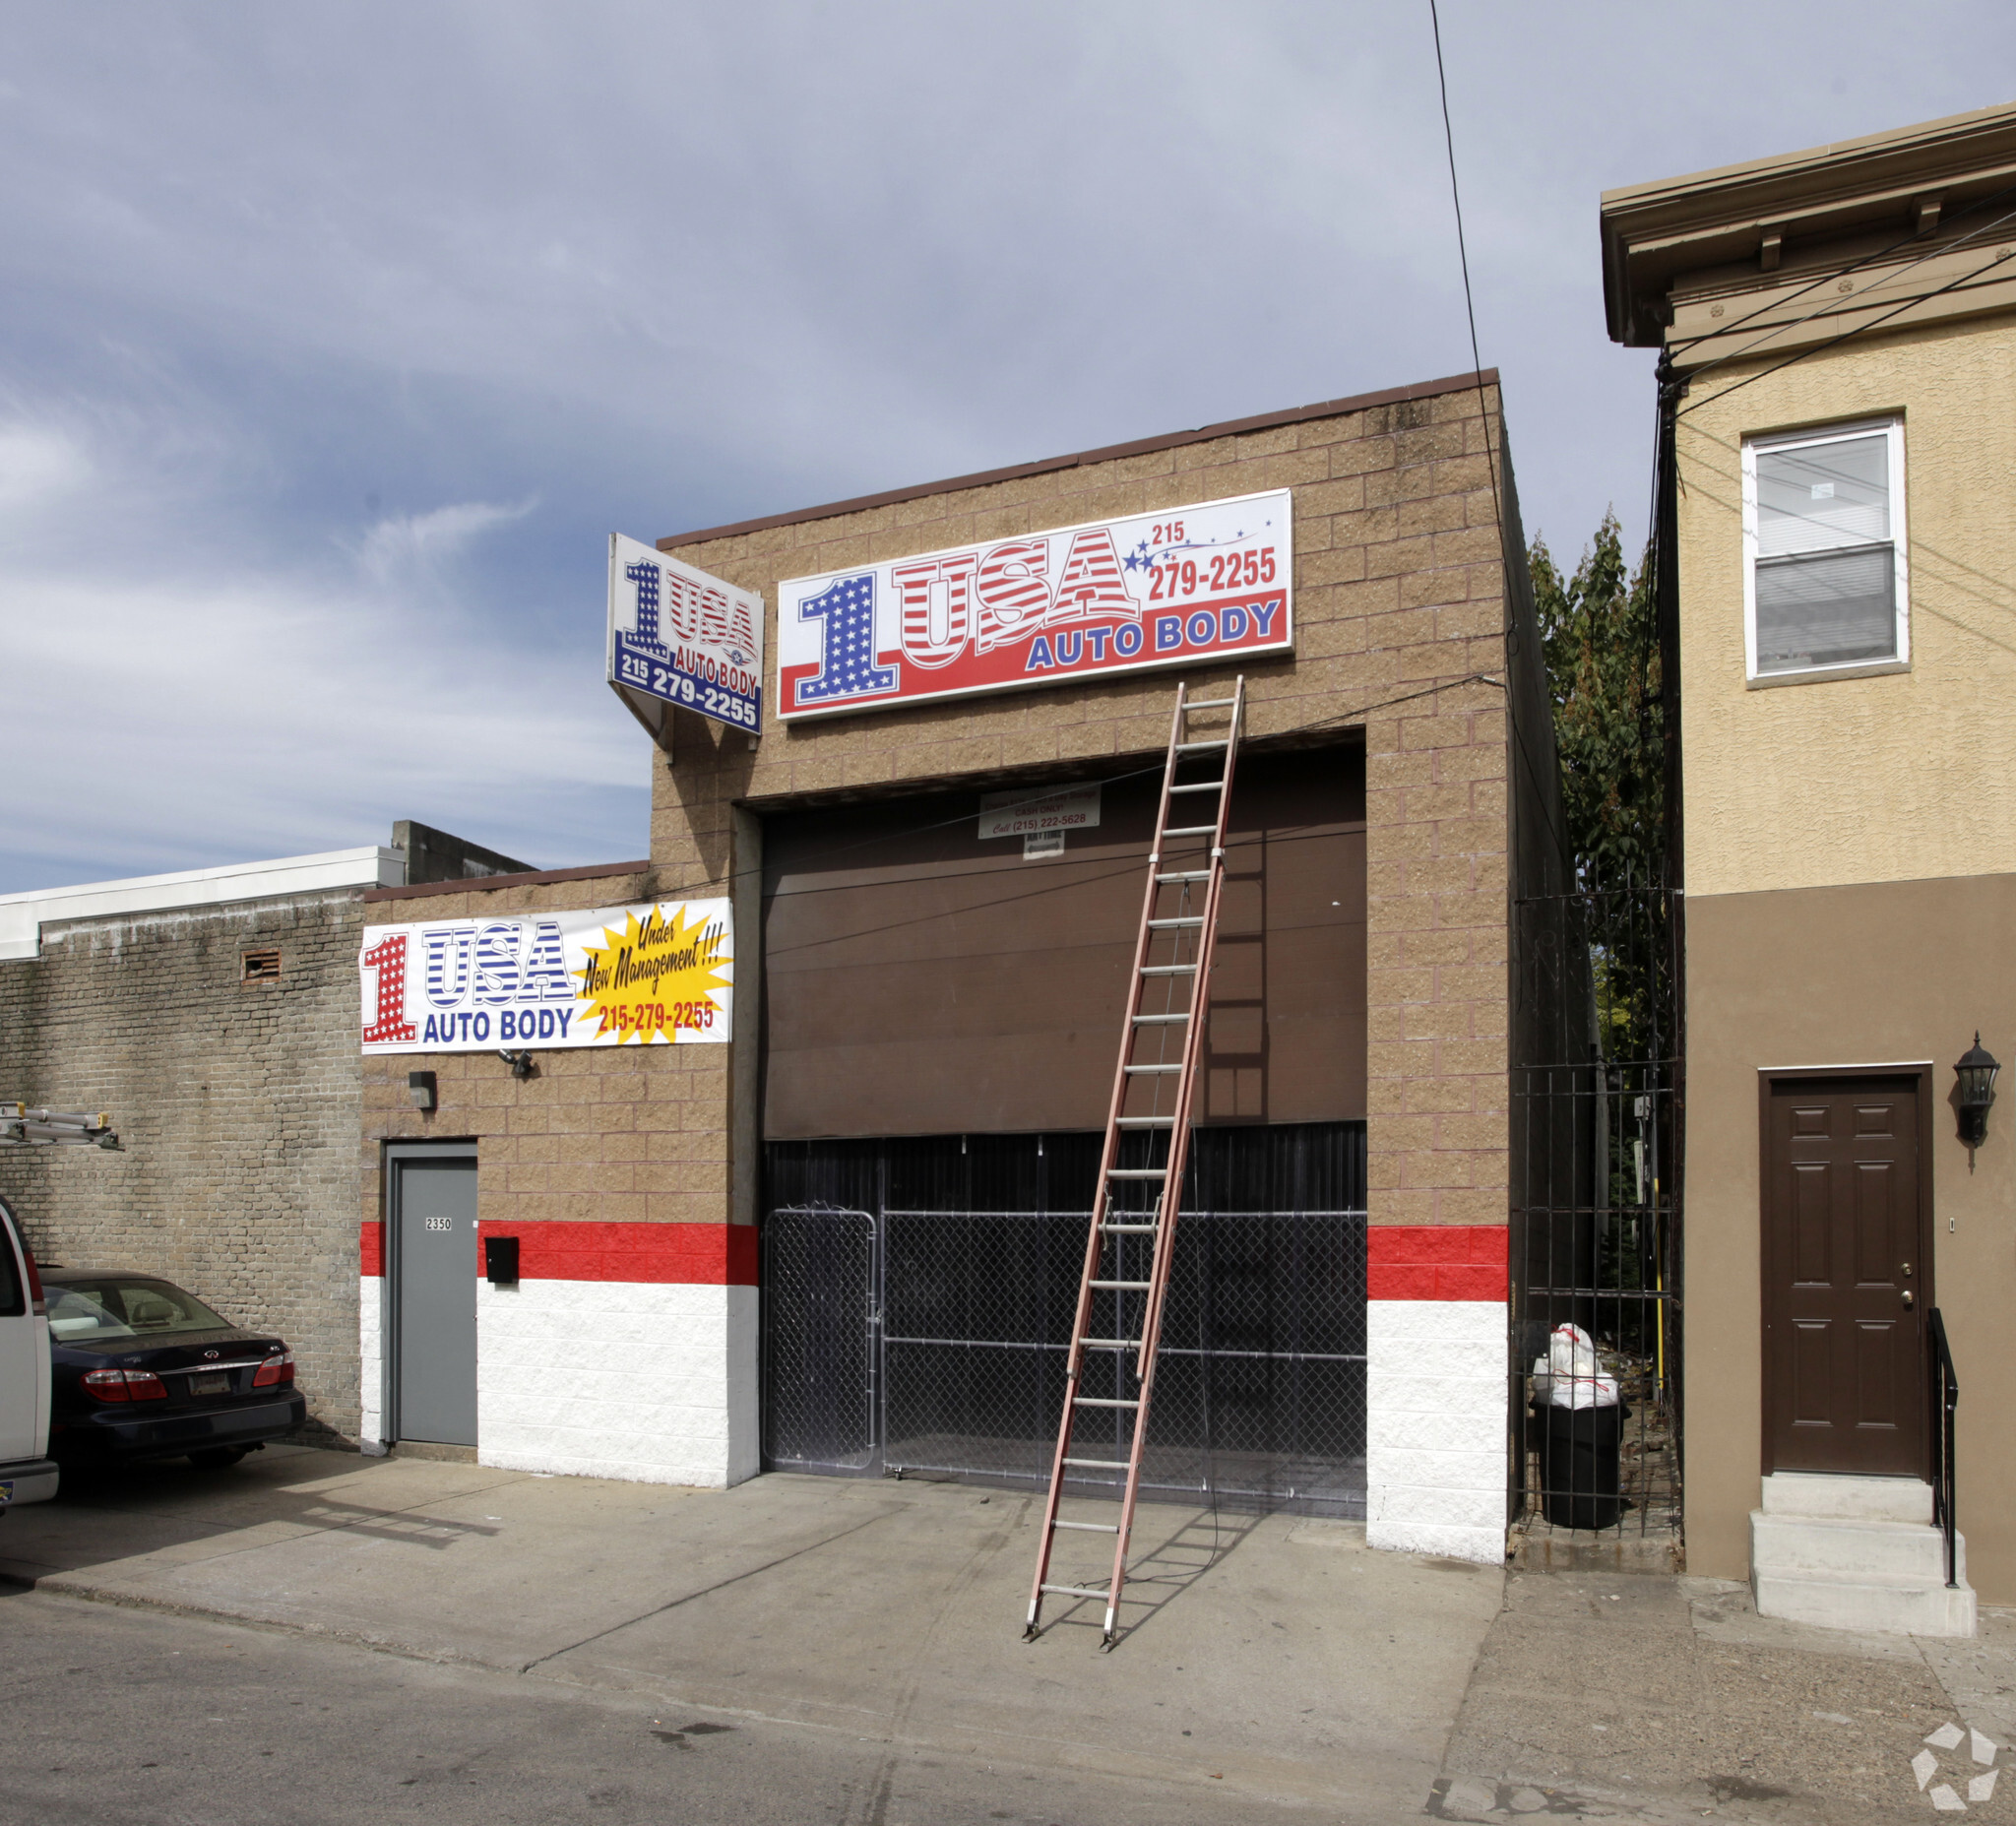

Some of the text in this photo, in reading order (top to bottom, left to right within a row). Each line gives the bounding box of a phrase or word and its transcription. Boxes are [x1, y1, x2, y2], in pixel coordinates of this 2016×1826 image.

[1152, 521, 1185, 545] 215
[1149, 547, 1276, 601] 279-2255
[623, 557, 758, 664] 1 USA
[795, 528, 1142, 706] 1 USA
[1025, 600, 1280, 671] AUTO BODY
[621, 654, 756, 726] 215 279-2255
[673, 645, 758, 699] AUTO BODY
[992, 813, 1087, 834] Call (215) 222-5628
[1015, 807, 1039, 817] CASH
[638, 914, 676, 951] Under
[361, 921, 577, 1045] 1 USA
[583, 952, 612, 997] New
[422, 1007, 574, 1043] AUTO BODY
[598, 1001, 714, 1032] 215-279-2255
[427, 1219, 451, 1229] 2350
